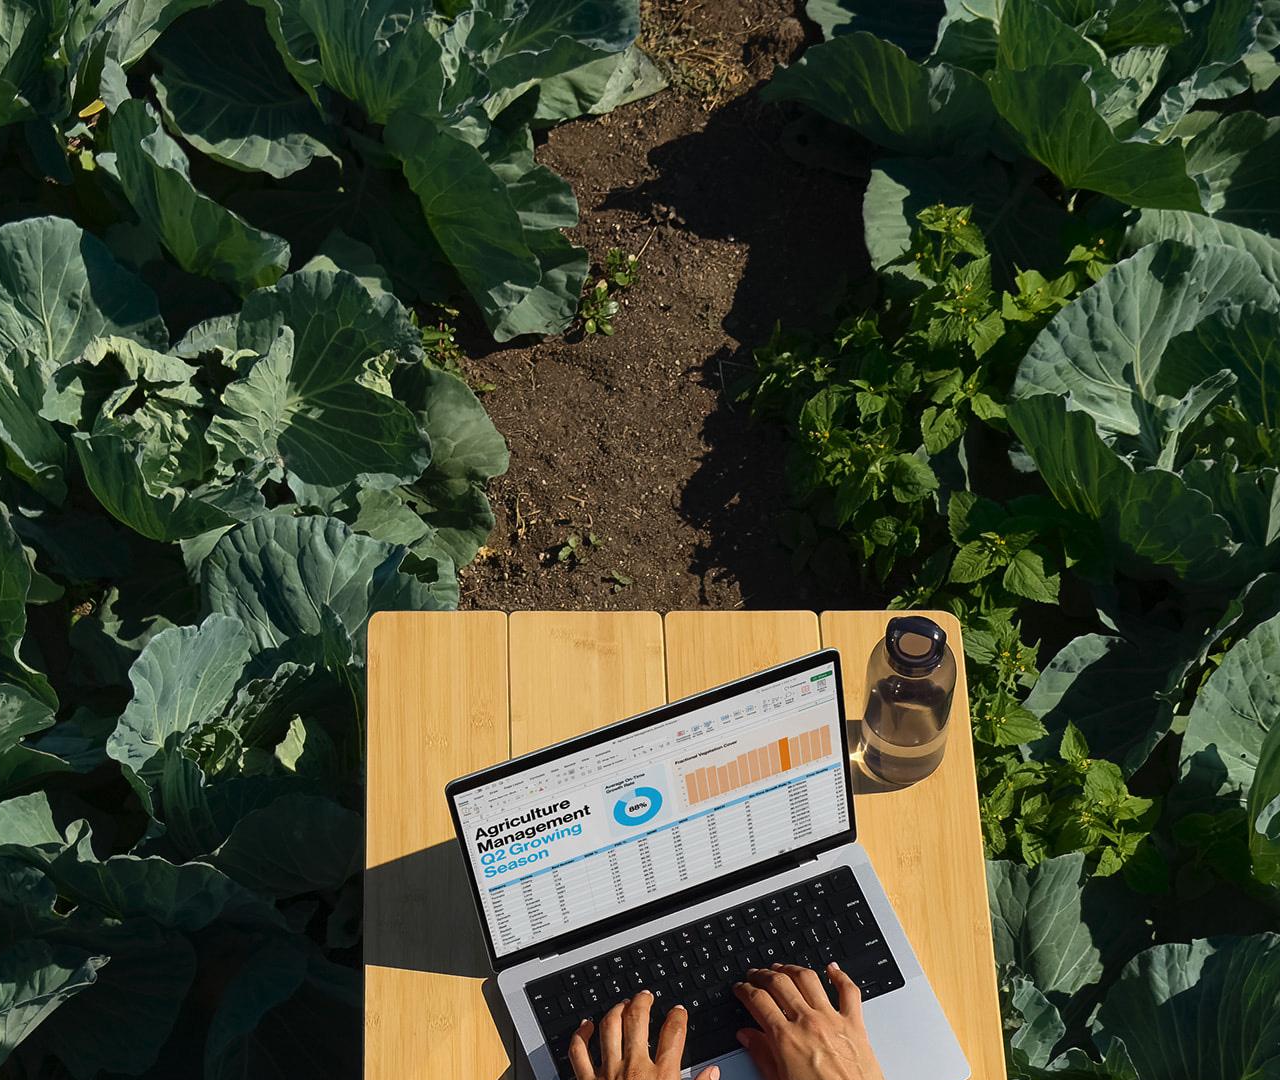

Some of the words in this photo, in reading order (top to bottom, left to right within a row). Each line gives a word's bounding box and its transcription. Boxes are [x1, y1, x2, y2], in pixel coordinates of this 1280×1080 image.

[674, 754, 697, 764] Fractional
[698, 745, 723, 756] Vegetation
[604, 780, 624, 789] Average
[605, 785, 623, 793] Growth
[628, 802, 647, 812] 88%
[475, 799, 570, 840] Agriculture
[476, 804, 591, 853] Management
[480, 849, 506, 865] Q2
[508, 823, 582, 855] Growing
[483, 849, 548, 877] Season
[790, 940, 796, 948] P
[700, 973, 707, 981] Y
